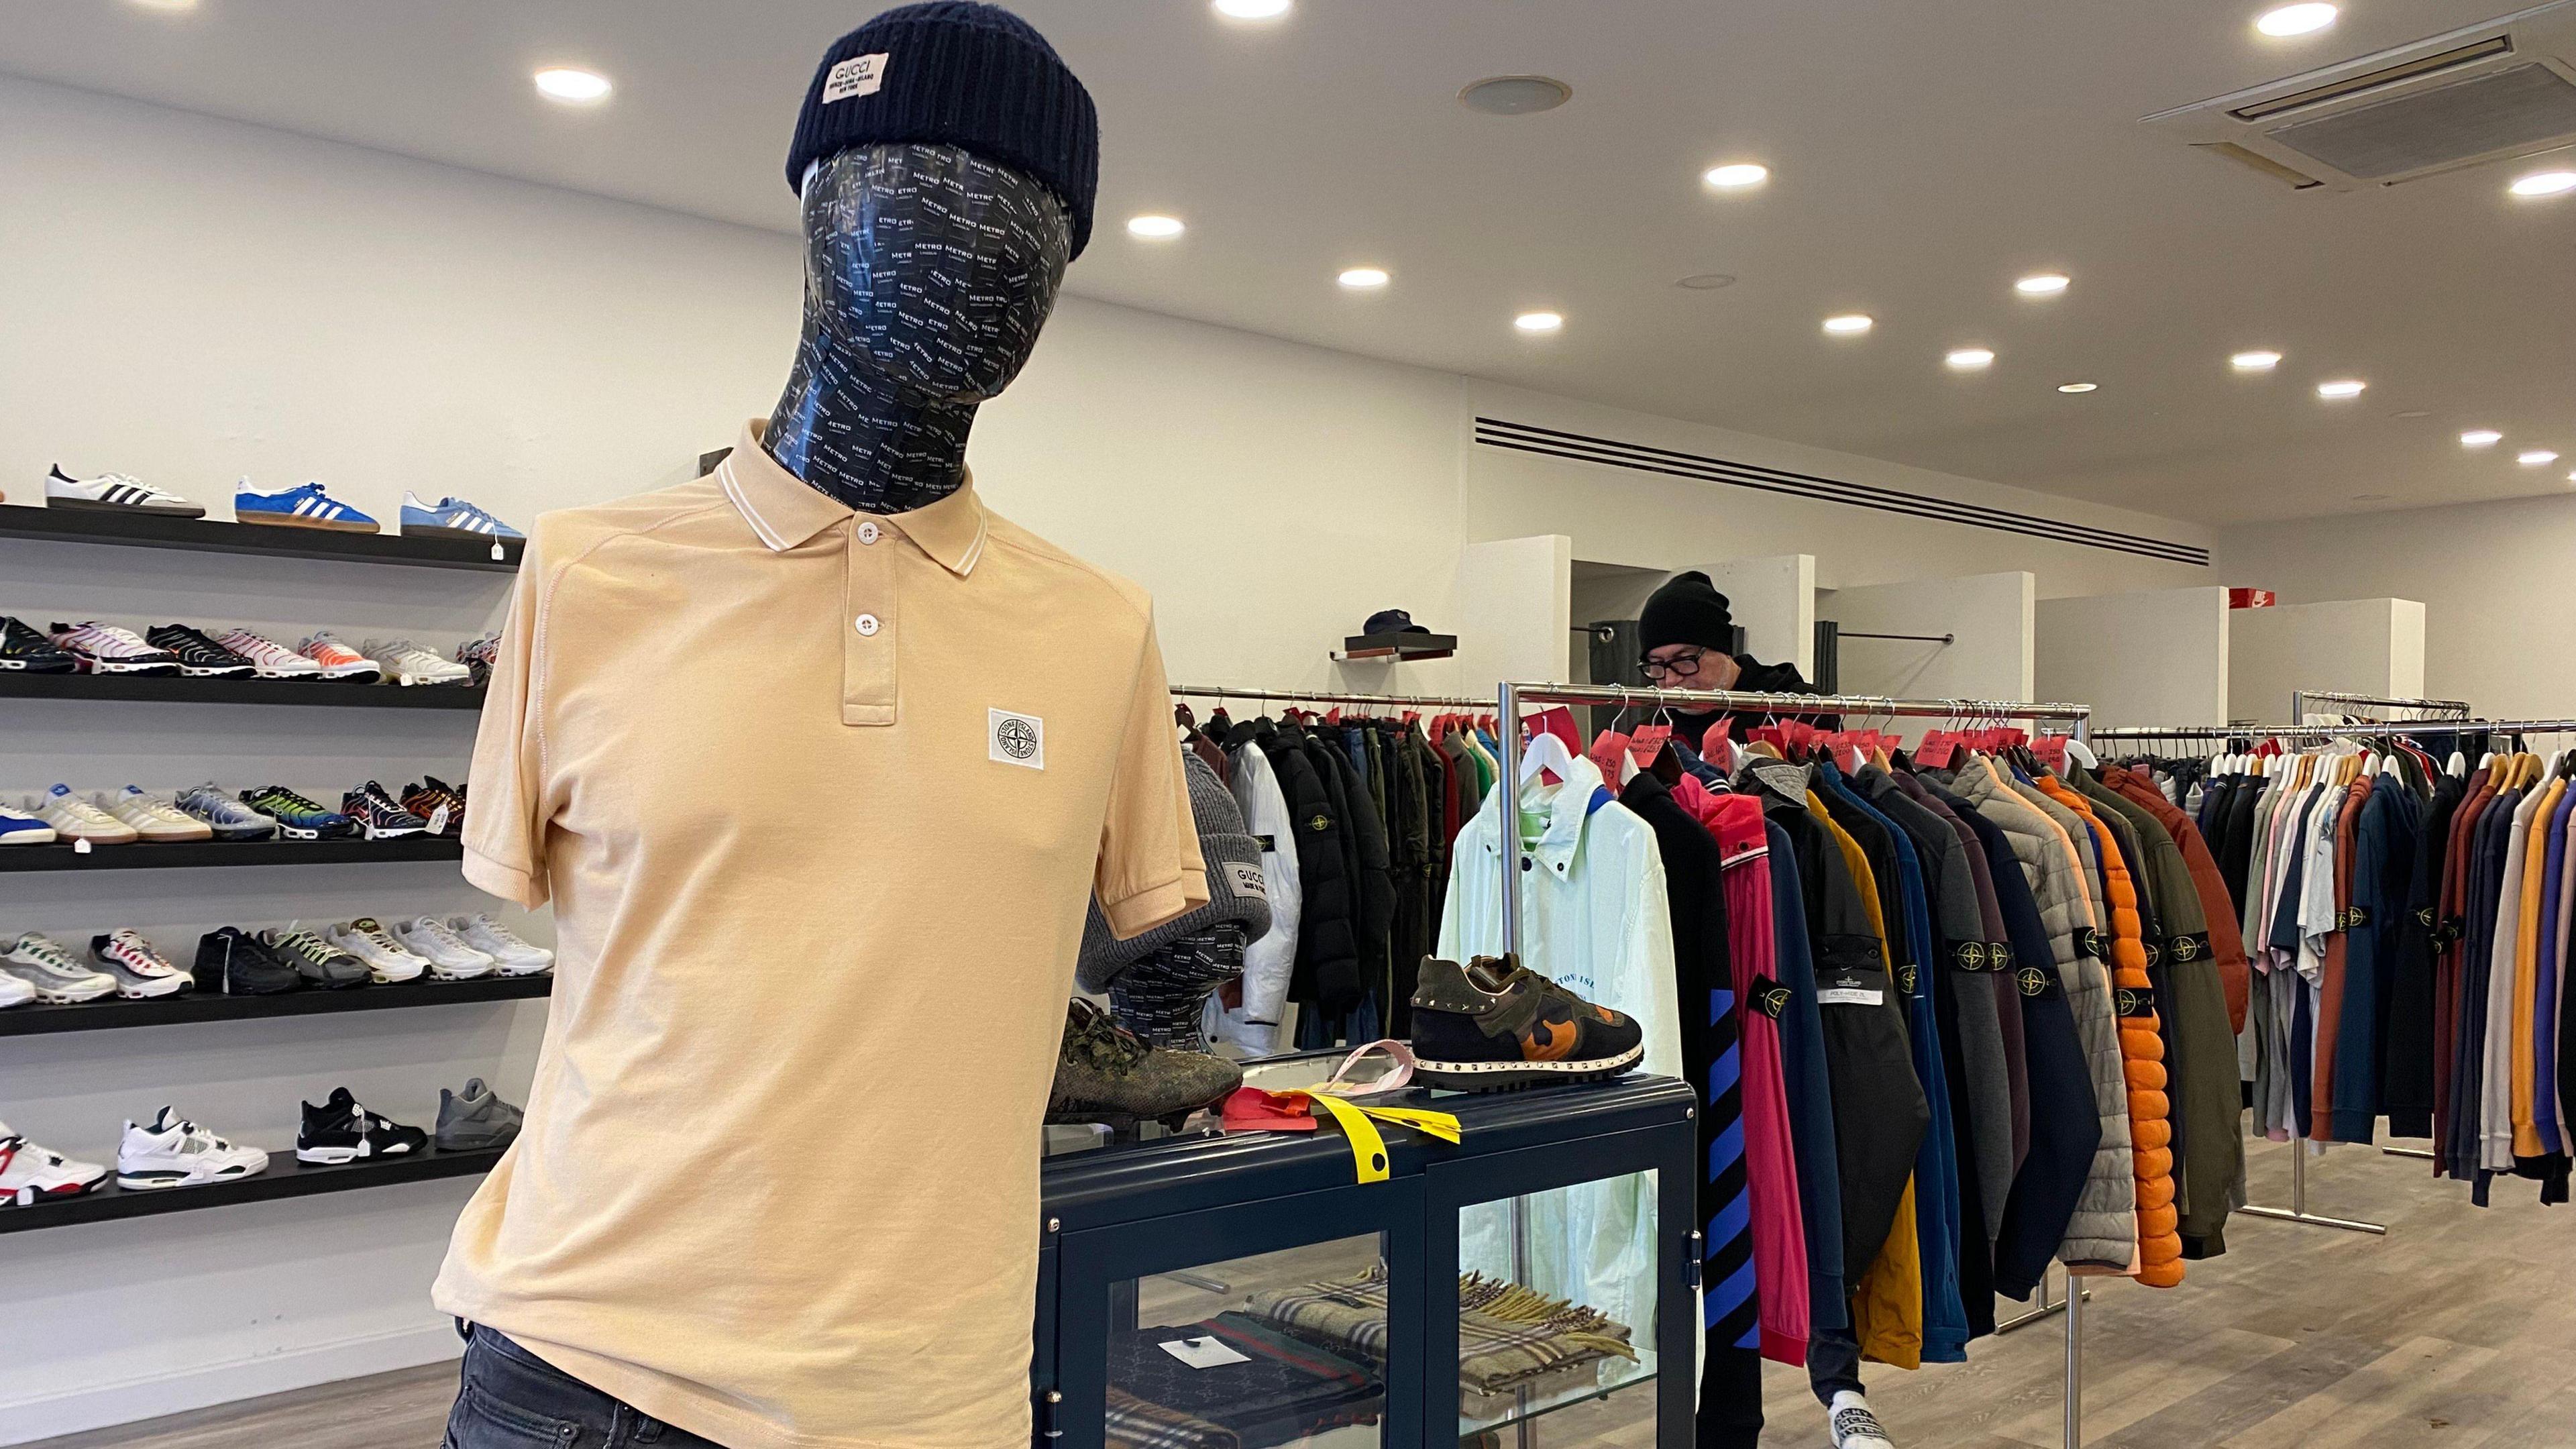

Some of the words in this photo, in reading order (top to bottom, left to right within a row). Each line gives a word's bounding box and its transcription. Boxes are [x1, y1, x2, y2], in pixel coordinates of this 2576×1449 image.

[836, 60, 870, 78] GUCCI
[913, 172, 940, 184] METRO
[872, 184, 895, 195] METRO
[921, 197, 948, 213] METRO
[898, 219, 914, 227] ETR
[949, 213, 977, 228] METRO
[979, 224, 1006, 235] METRO
[945, 244, 973, 260] METRO
[835, 274, 853, 288] METRO
[872, 270, 896, 280] METRO
[930, 270, 951, 286] ETRO
[923, 297, 951, 315] METRO
[898, 311, 924, 326] METRO
[928, 319, 949, 331] ETRO
[936, 337, 963, 355] METRO
[828, 352, 848, 372] METRO
[937, 356, 963, 372] METRO
[932, 381, 959, 390] METRO
[837, 389, 858, 411] METRO
[872, 417, 898, 427] METRO
[823, 444, 848, 462] METRO
[880, 442, 904, 459] METRO
[812, 455, 838, 473] METRO
[839, 471, 864, 486] METRO
[892, 473, 914, 482] METRO
[1000, 721, 1015, 735] STONE
[1019, 722, 1034, 741] ISLAND
